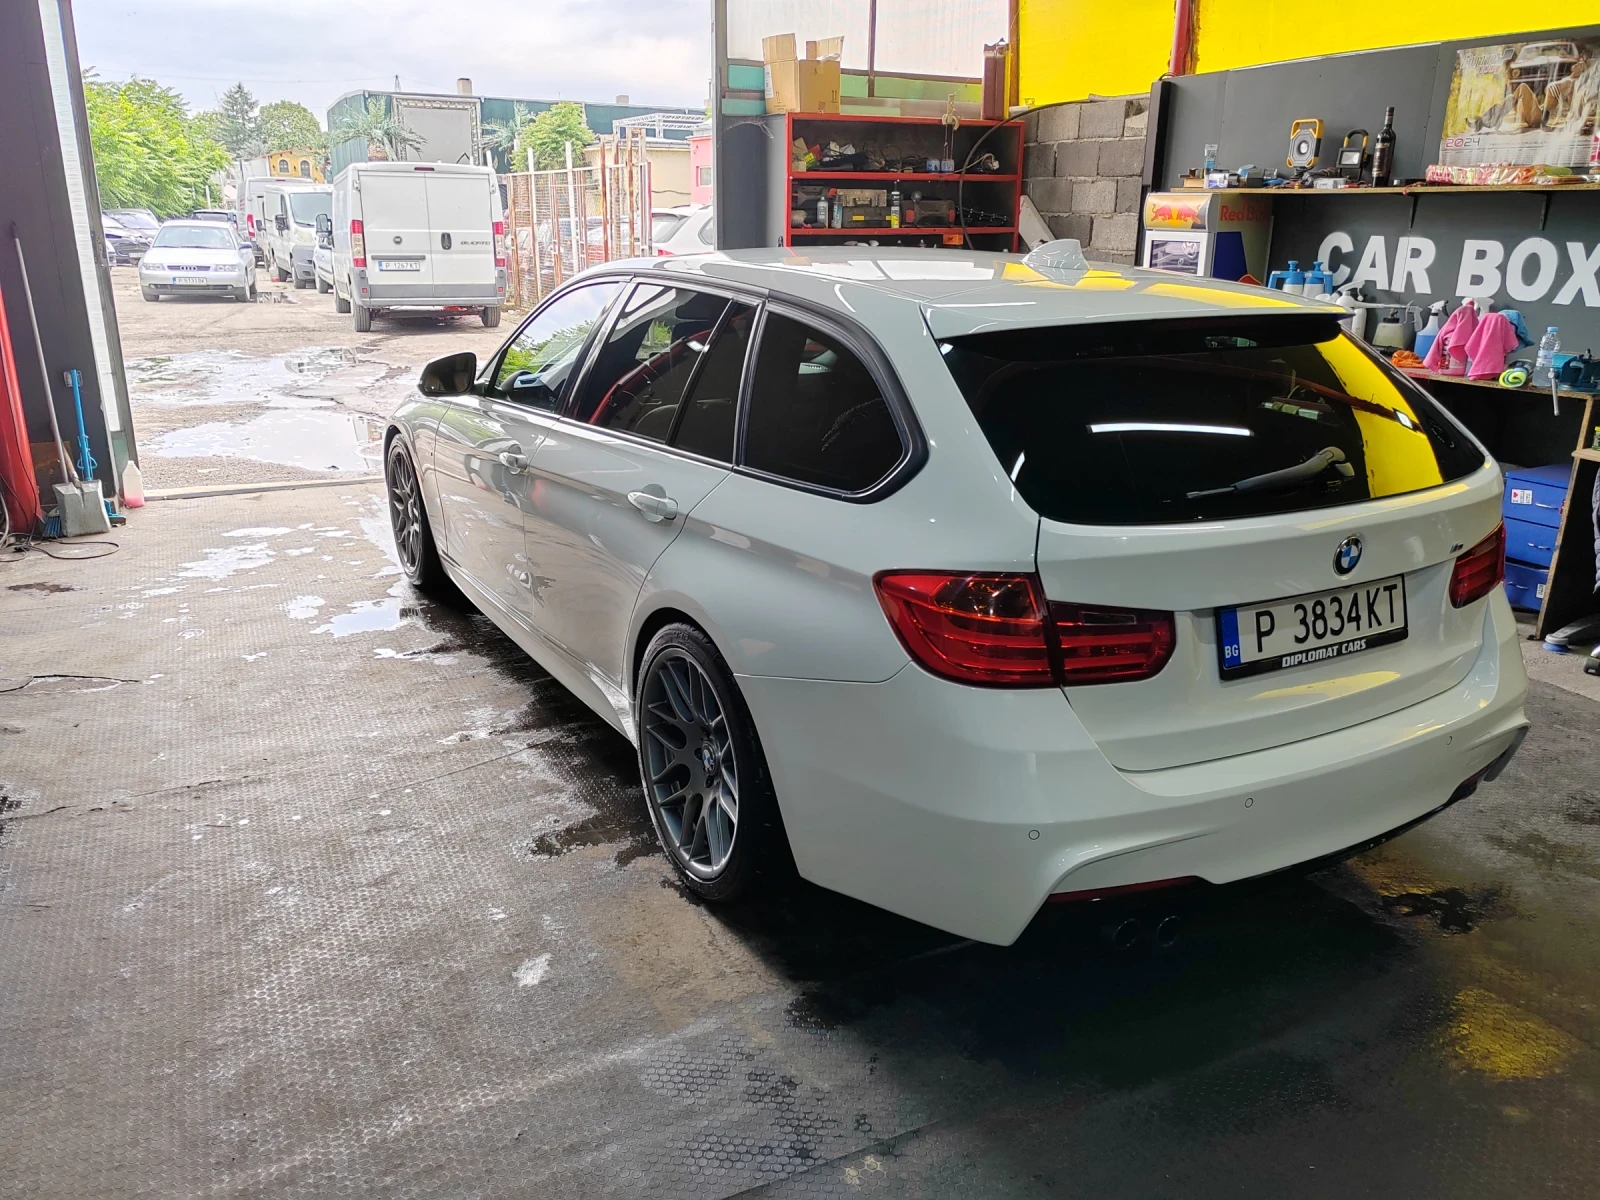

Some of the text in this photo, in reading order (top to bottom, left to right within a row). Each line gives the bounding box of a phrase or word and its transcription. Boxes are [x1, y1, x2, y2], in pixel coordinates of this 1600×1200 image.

[1445, 137, 1481, 148] 2024
[1220, 200, 1247, 221] Red
[1317, 231, 1600, 308] CAR BOX
[1255, 584, 1398, 653] P 3834KT
[1224, 644, 1239, 659] BG
[1282, 638, 1367, 668] DIPLOMAT CARS
